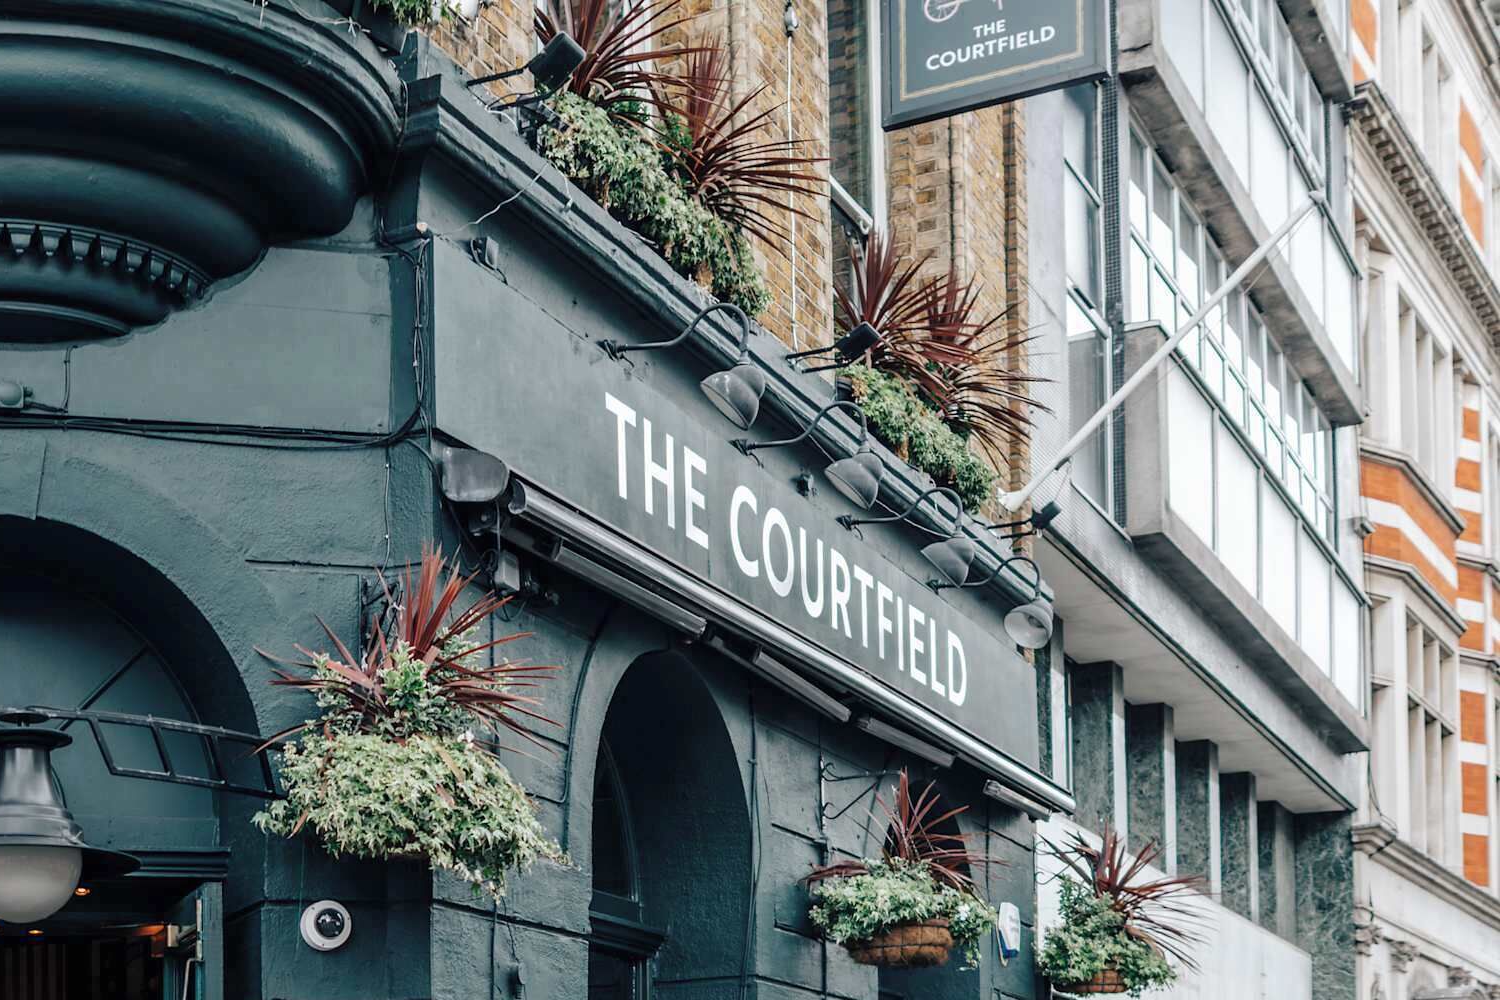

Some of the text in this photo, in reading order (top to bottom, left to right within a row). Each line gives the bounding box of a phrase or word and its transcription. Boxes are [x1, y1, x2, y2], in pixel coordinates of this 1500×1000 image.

[925, 25, 1056, 71] COURTFIELD
[973, 19, 1006, 38] THE
[604, 391, 967, 707] THE COURTFIELD
